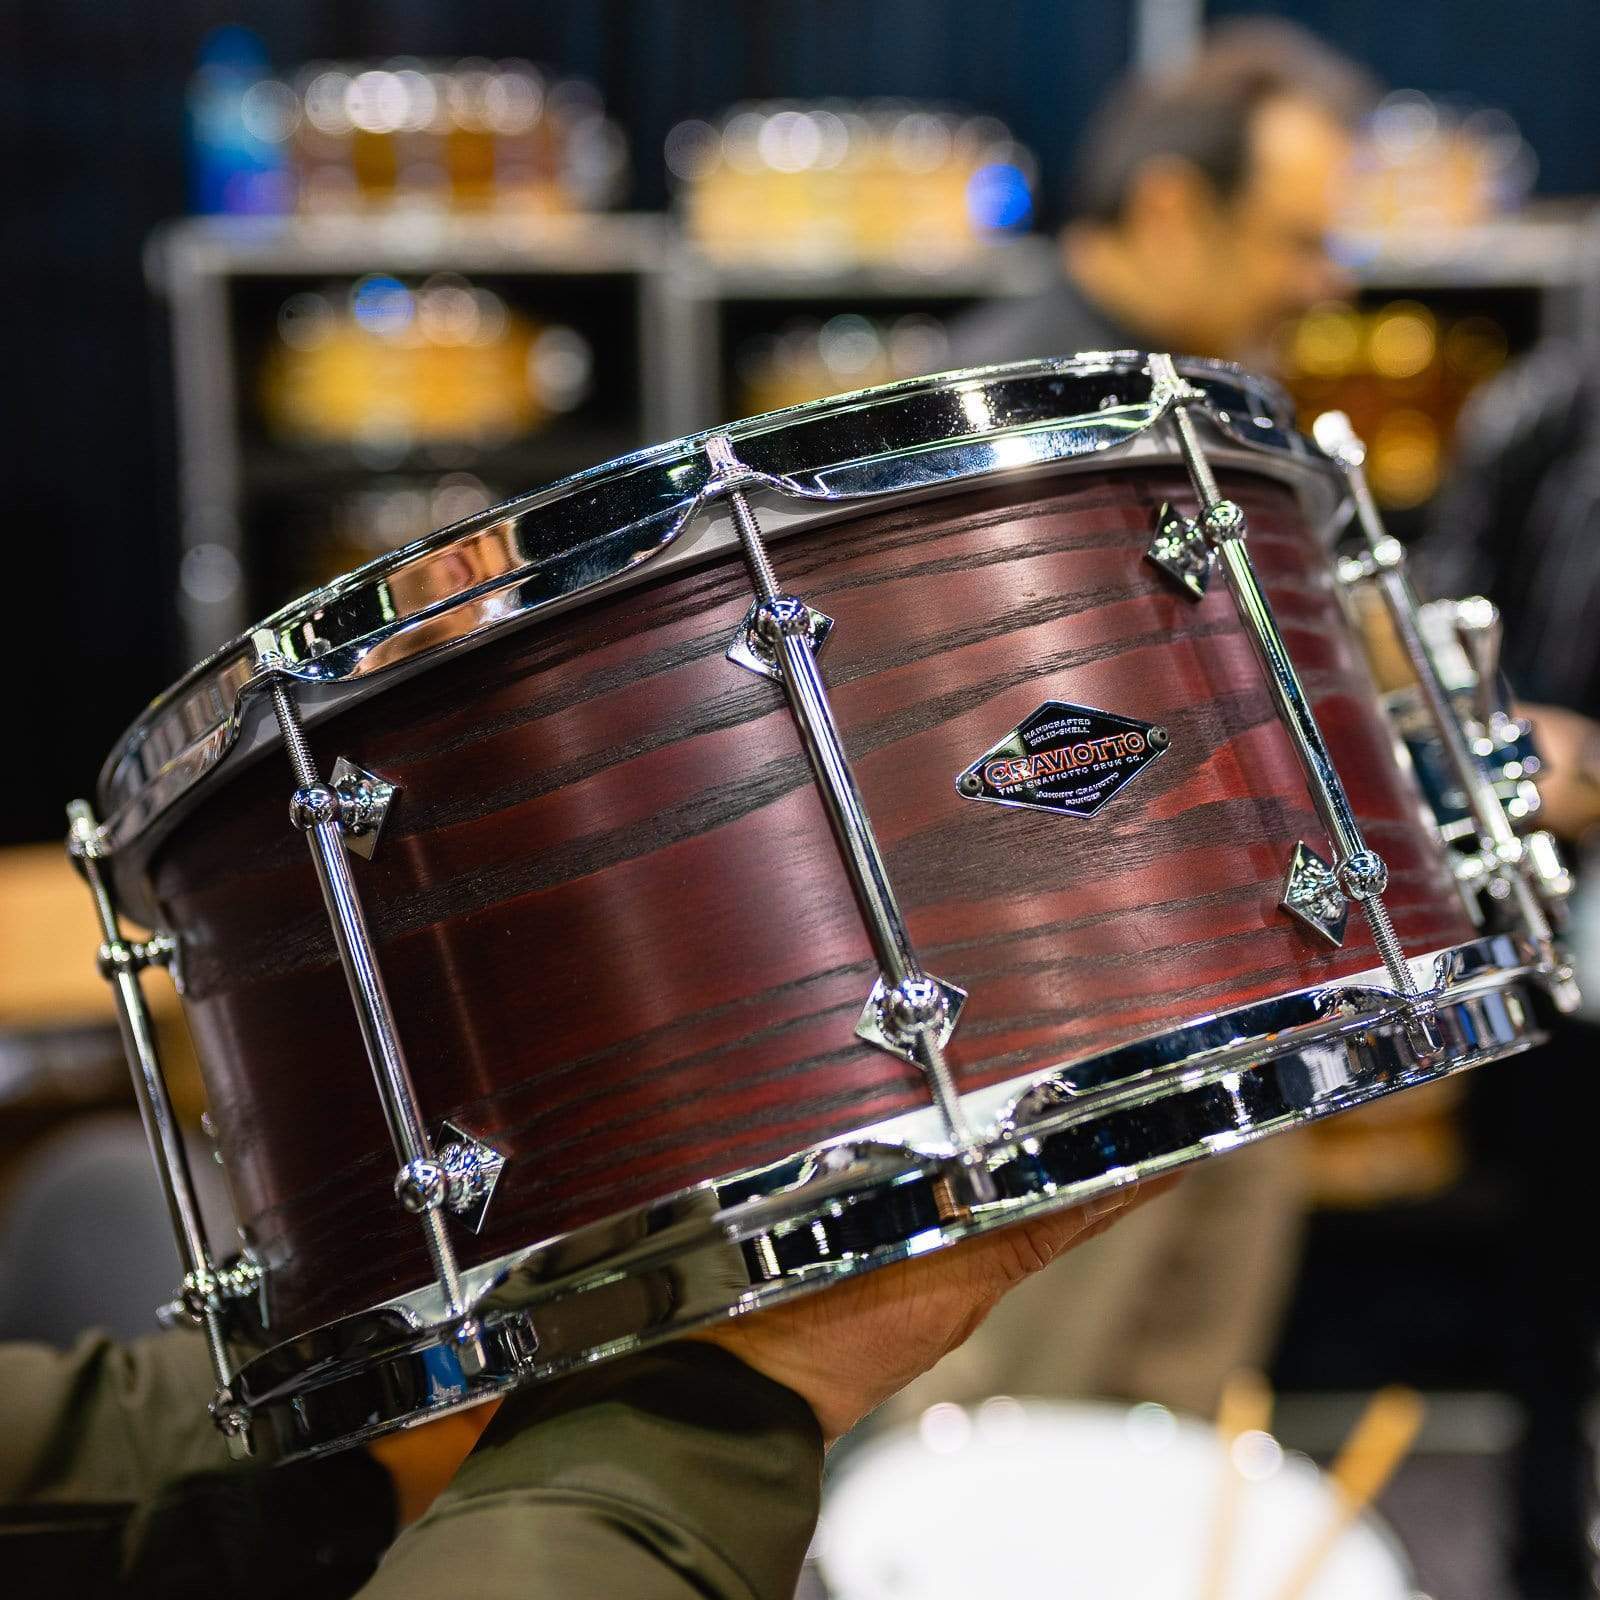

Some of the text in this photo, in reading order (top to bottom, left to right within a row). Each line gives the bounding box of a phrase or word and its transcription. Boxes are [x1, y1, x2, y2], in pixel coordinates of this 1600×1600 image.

[1023, 718, 1091, 740] HANDCRAFTED
[1030, 726, 1090, 746] SOLID-SHELL
[985, 732, 1145, 788] CRAVIOTTO
[998, 783, 1023, 796] THE
[1026, 766, 1089, 789] CRAVIOTTO
[1092, 759, 1122, 771] DRUM
